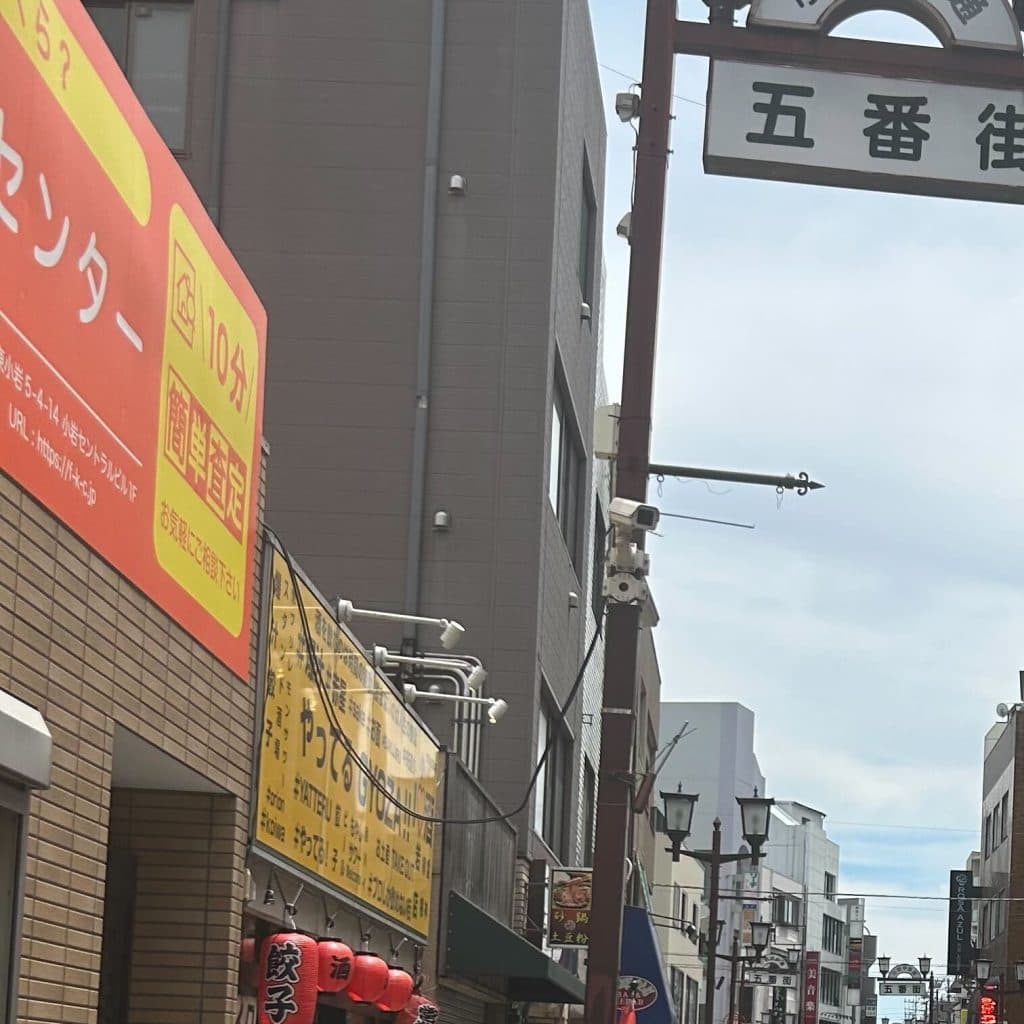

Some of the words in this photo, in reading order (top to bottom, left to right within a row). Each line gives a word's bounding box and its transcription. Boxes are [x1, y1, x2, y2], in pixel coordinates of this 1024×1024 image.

[208, 304, 248, 414] 10分
[167, 386, 247, 534] 簡単査定
[160, 497, 241, 603] お気軽にご相談下さい
[300, 694, 353, 794] やってる
[264, 941, 302, 1024] 餃子
[329, 955, 350, 981] 酒
[753, 974, 792, 986] 五番街
